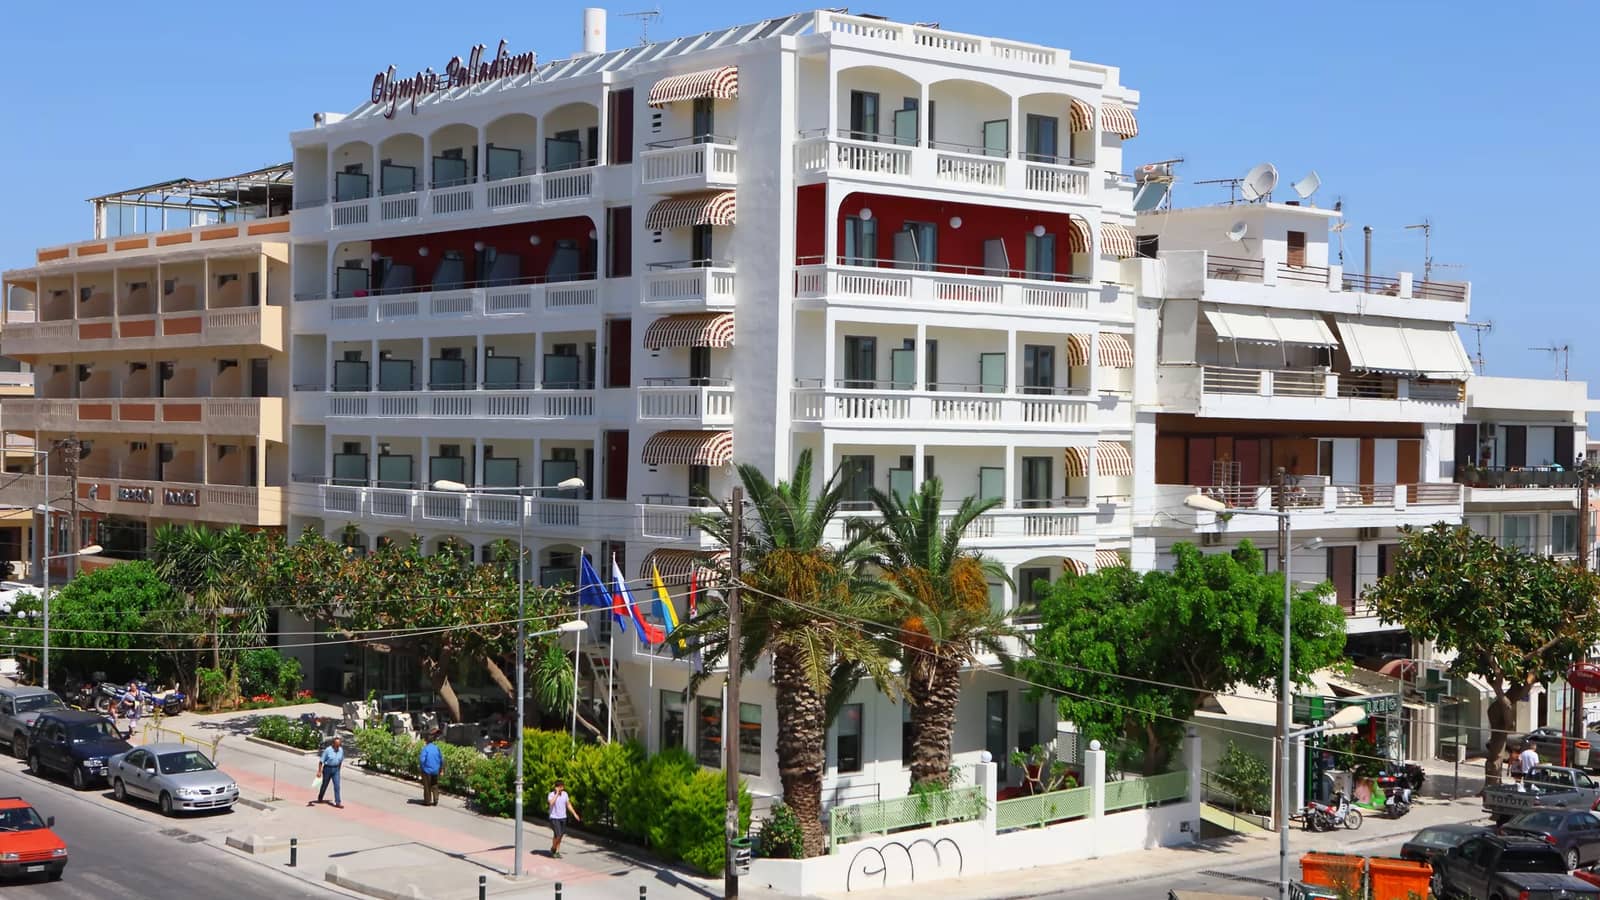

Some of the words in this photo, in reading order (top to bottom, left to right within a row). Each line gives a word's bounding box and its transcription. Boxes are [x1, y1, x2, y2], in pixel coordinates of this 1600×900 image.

[371, 65, 437, 120] Olympic
[446, 39, 536, 89] Palladium
[1491, 794, 1529, 807] TOYOTA
